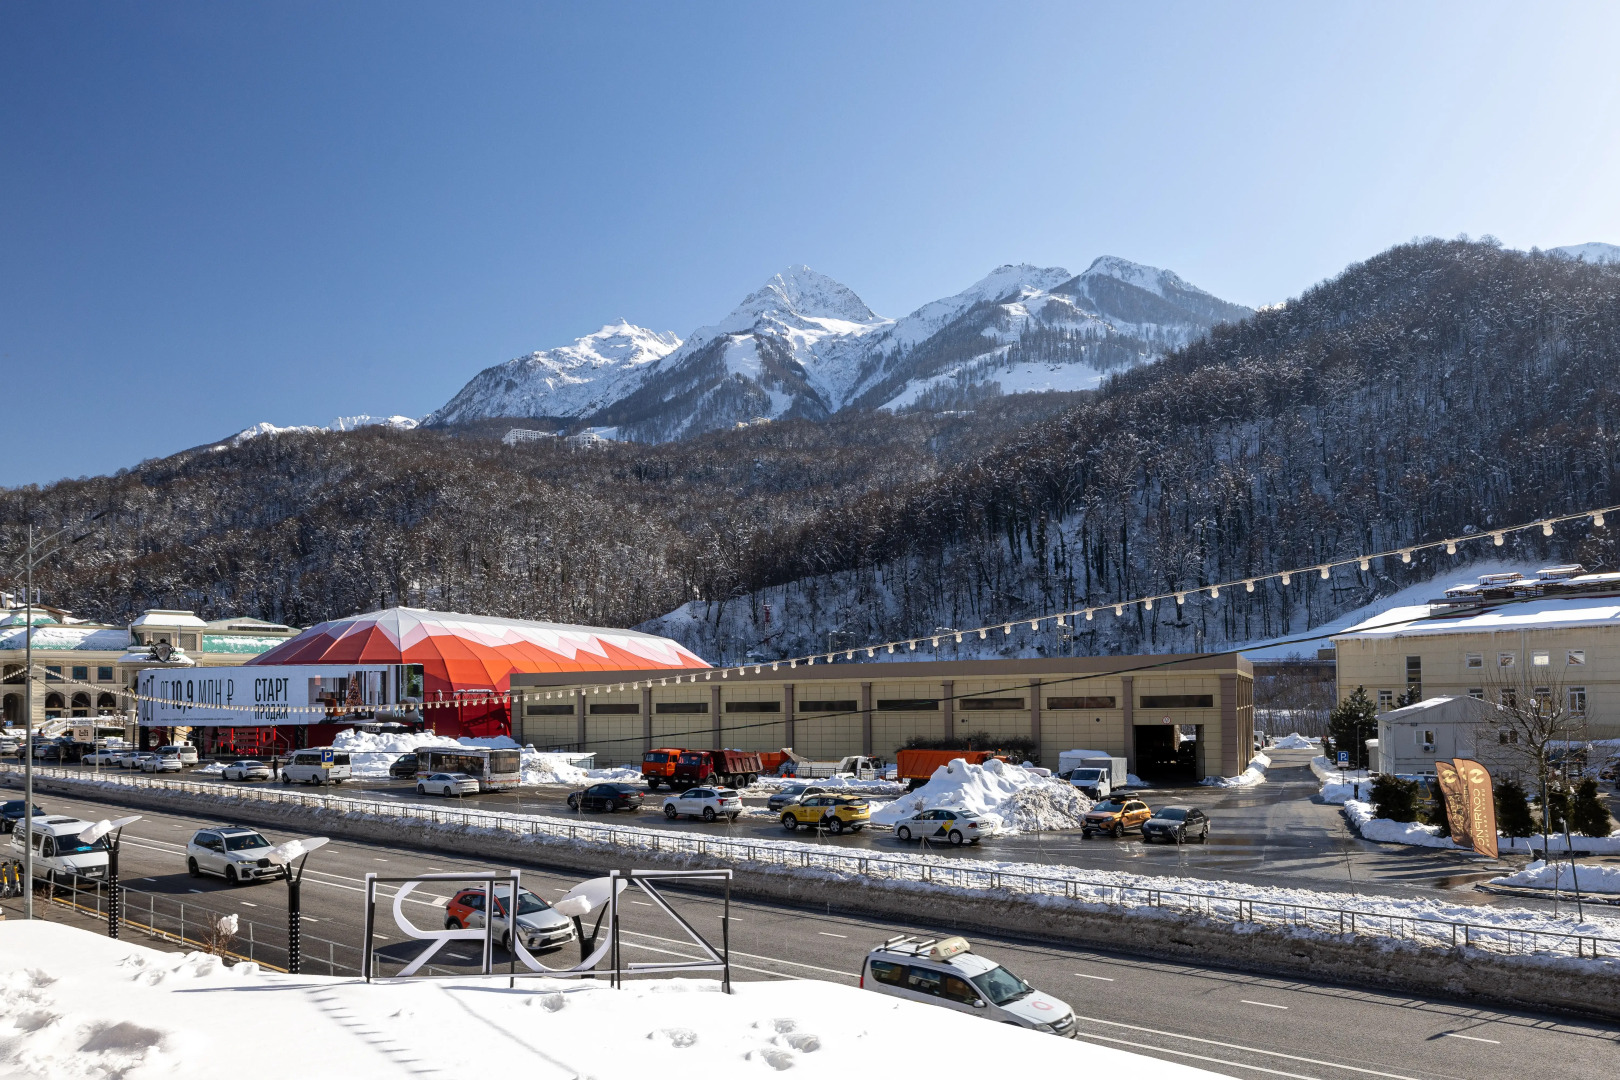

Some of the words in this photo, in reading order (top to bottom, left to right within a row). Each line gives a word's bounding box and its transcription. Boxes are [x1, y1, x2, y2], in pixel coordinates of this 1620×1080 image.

[171, 680, 193, 714] 10,9
[255, 678, 289, 702] СТАРТ
[255, 704, 289, 721] ПРОДАЖ
[324, 751, 332, 761] P
[1340, 752, 1347, 761] P
